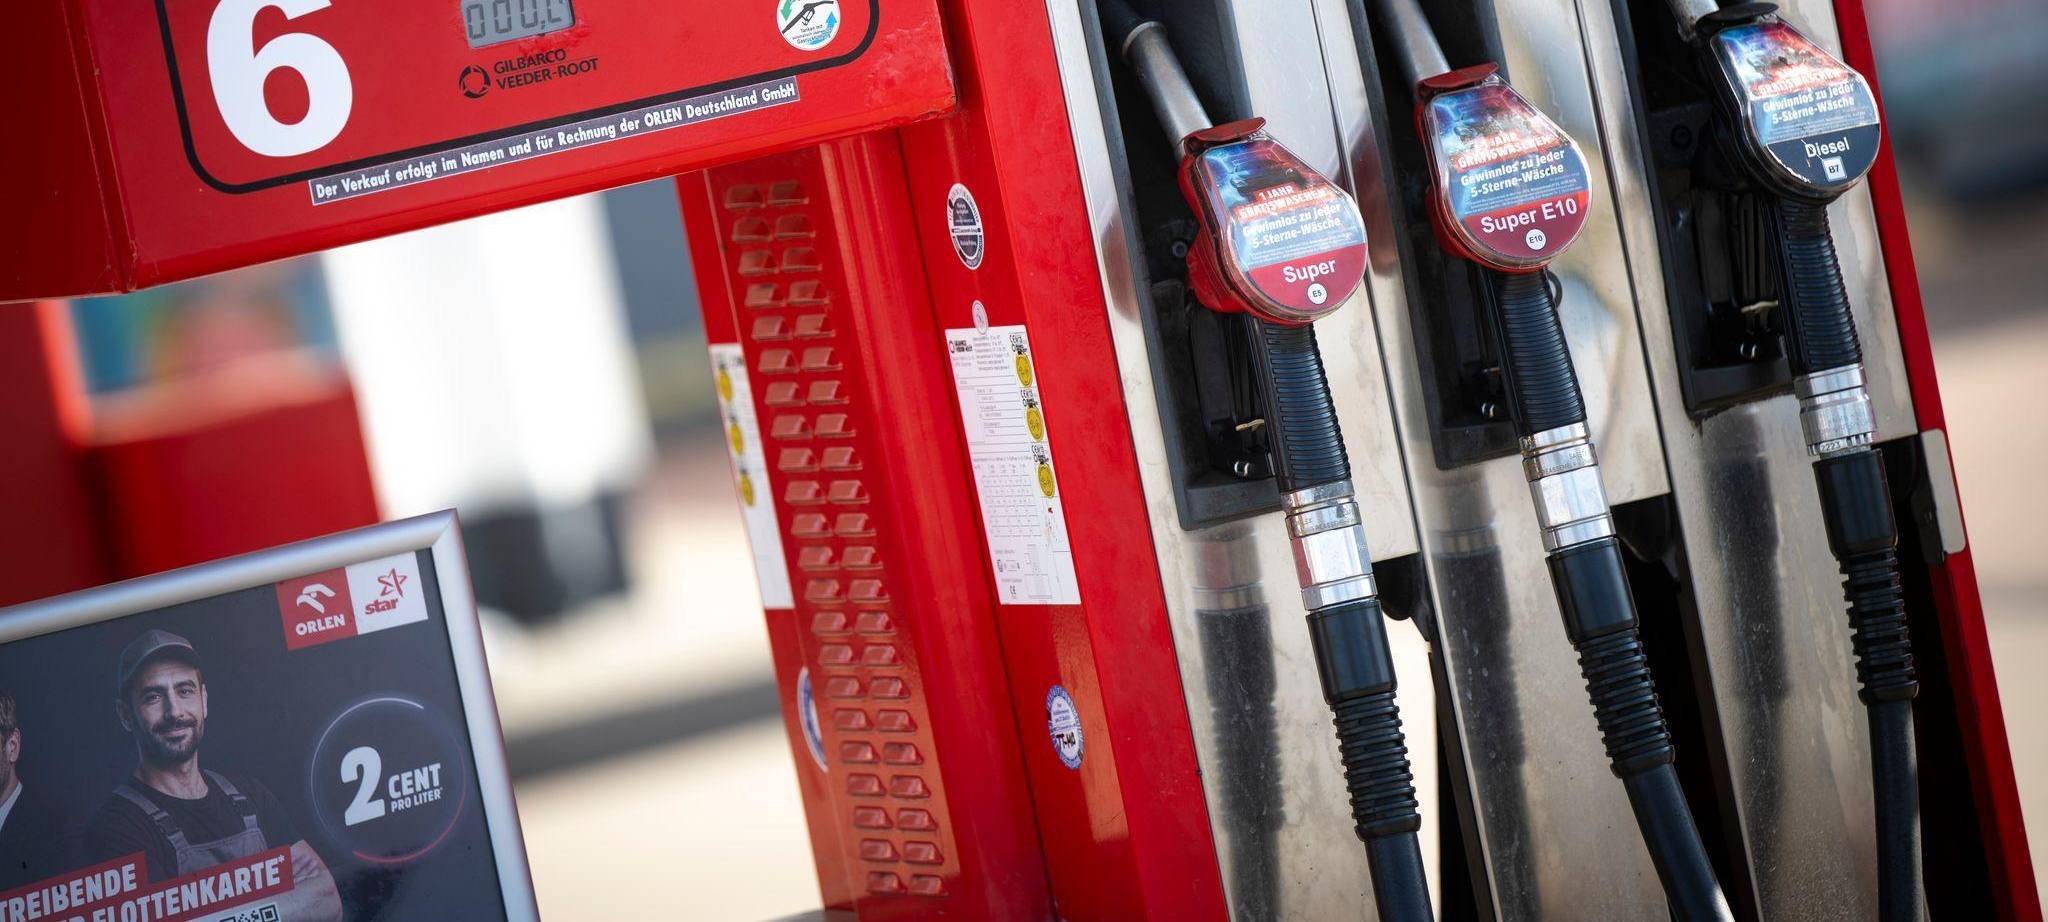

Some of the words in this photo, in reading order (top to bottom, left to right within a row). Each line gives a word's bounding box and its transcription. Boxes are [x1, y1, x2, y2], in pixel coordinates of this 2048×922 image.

[494, 48, 566, 74] GILBARCO
[496, 58, 599, 90] VEEDER-ROOT
[206, 0, 353, 157] 6
[1763, 89, 1814, 112] Gewinnlos
[1815, 88, 1828, 100] zu
[1829, 82, 1854, 97] jeder
[316, 184, 337, 199] Der
[341, 171, 390, 193] Verkauf
[395, 158, 437, 181] erfolgt
[442, 156, 458, 171] im
[461, 148, 504, 167] Namen
[509, 138, 532, 155] und
[536, 135, 554, 150] für
[558, 124, 616, 147] Rechnung
[620, 118, 640, 132] der
[644, 106, 682, 127] ORLEN
[686, 90, 757, 119] Deutschland
[762, 83, 796, 101] GmbH
[1805, 136, 1850, 158] Diesel
[1461, 163, 1518, 186] Gewinnlos
[1520, 159, 1534, 170] zu
[1535, 149, 1565, 167] jeder
[1471, 164, 1564, 197] 5-Sterne-Wäsche
[1829, 164, 1840, 173] B7
[1243, 215, 1297, 236] Gewinnlos
[1299, 211, 1312, 221] zu
[1313, 203, 1341, 220] jeder
[1481, 210, 1537, 233] Super
[1541, 198, 1577, 220] E10
[1252, 217, 1341, 248] 5-Sterne-Wäsche
[1529, 235, 1543, 243] E10
[1283, 260, 1336, 283] Super
[1312, 289, 1323, 298] E5
[365, 598, 399, 615] star
[295, 613, 346, 636] ORLEN
[341, 746, 386, 826] 2
[388, 763, 441, 799] CENT
[391, 796, 412, 813] PRO
